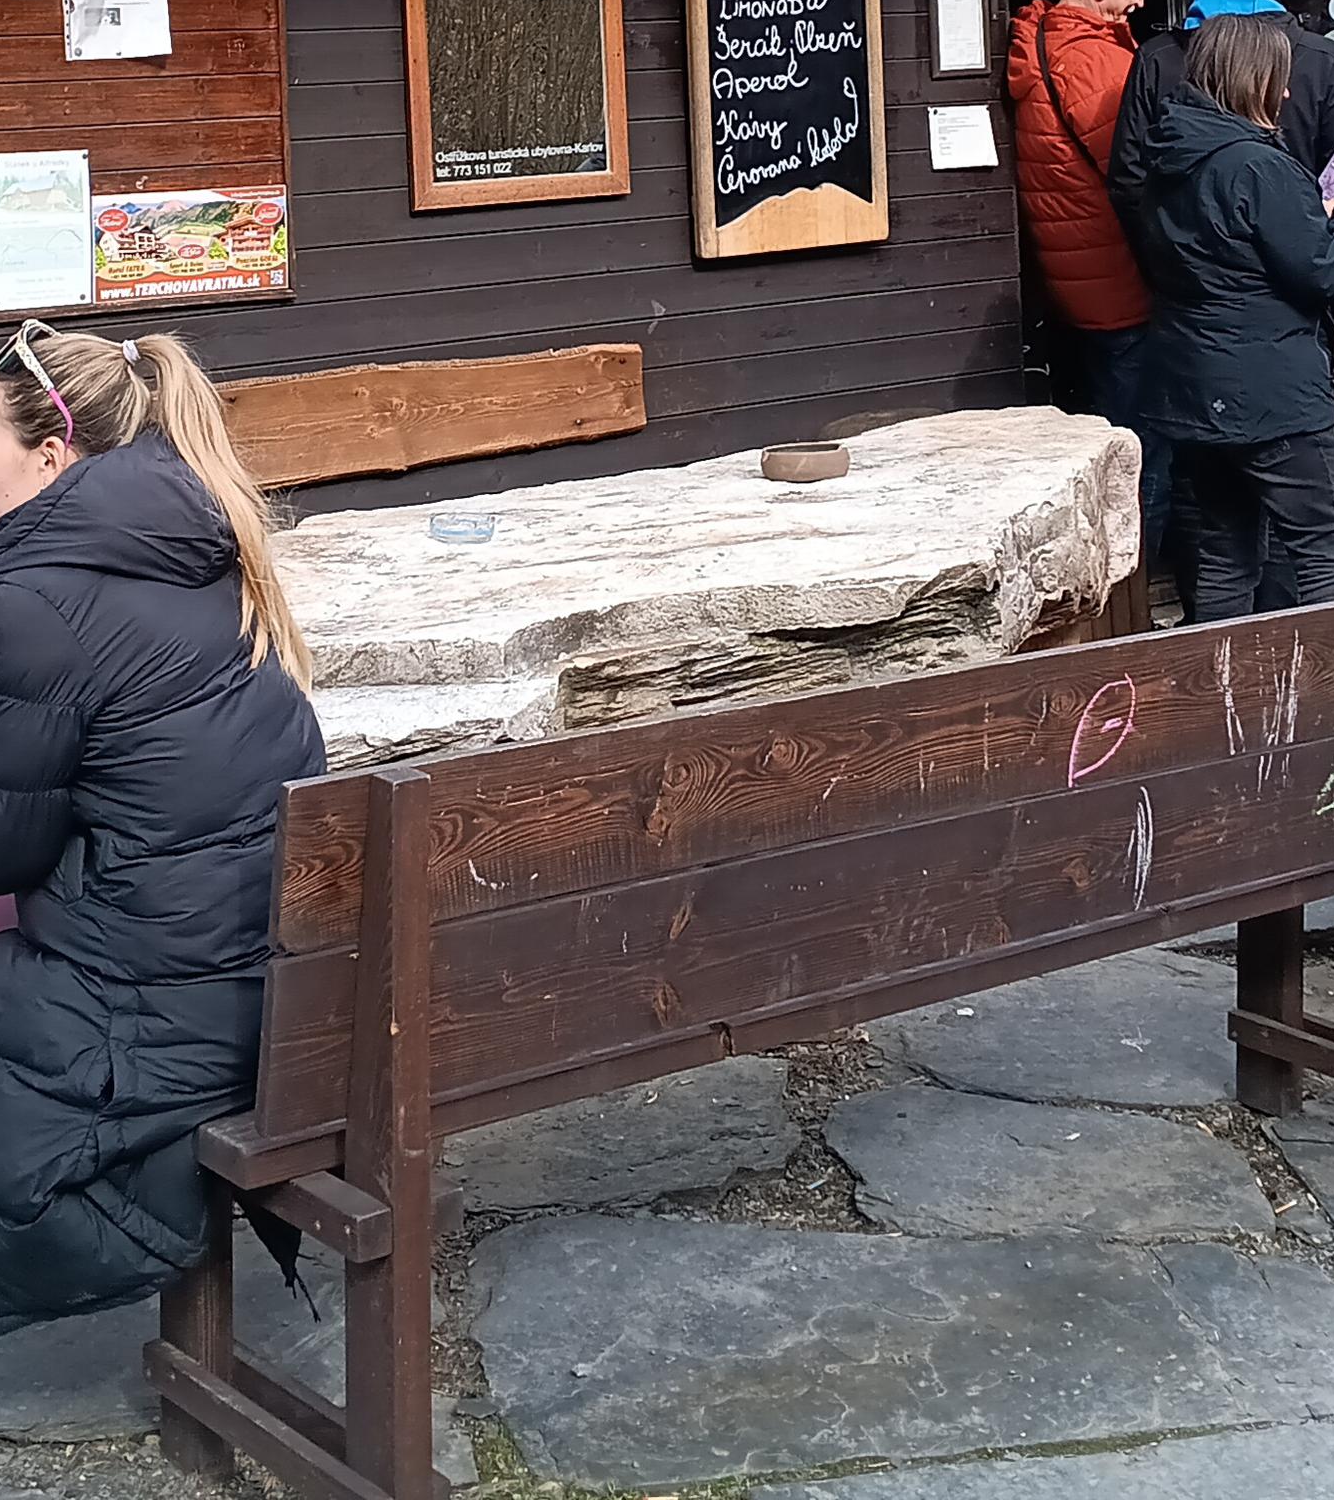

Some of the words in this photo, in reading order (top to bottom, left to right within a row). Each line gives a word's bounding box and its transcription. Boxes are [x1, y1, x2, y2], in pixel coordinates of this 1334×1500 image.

[713, 60, 809, 99] Aperol
[715, 110, 788, 150] Kávy
[453, 165, 472, 177] 773
[474, 164, 491, 175] 151
[493, 162, 512, 174] 022
[718, 141, 802, 194] Čepovaná
